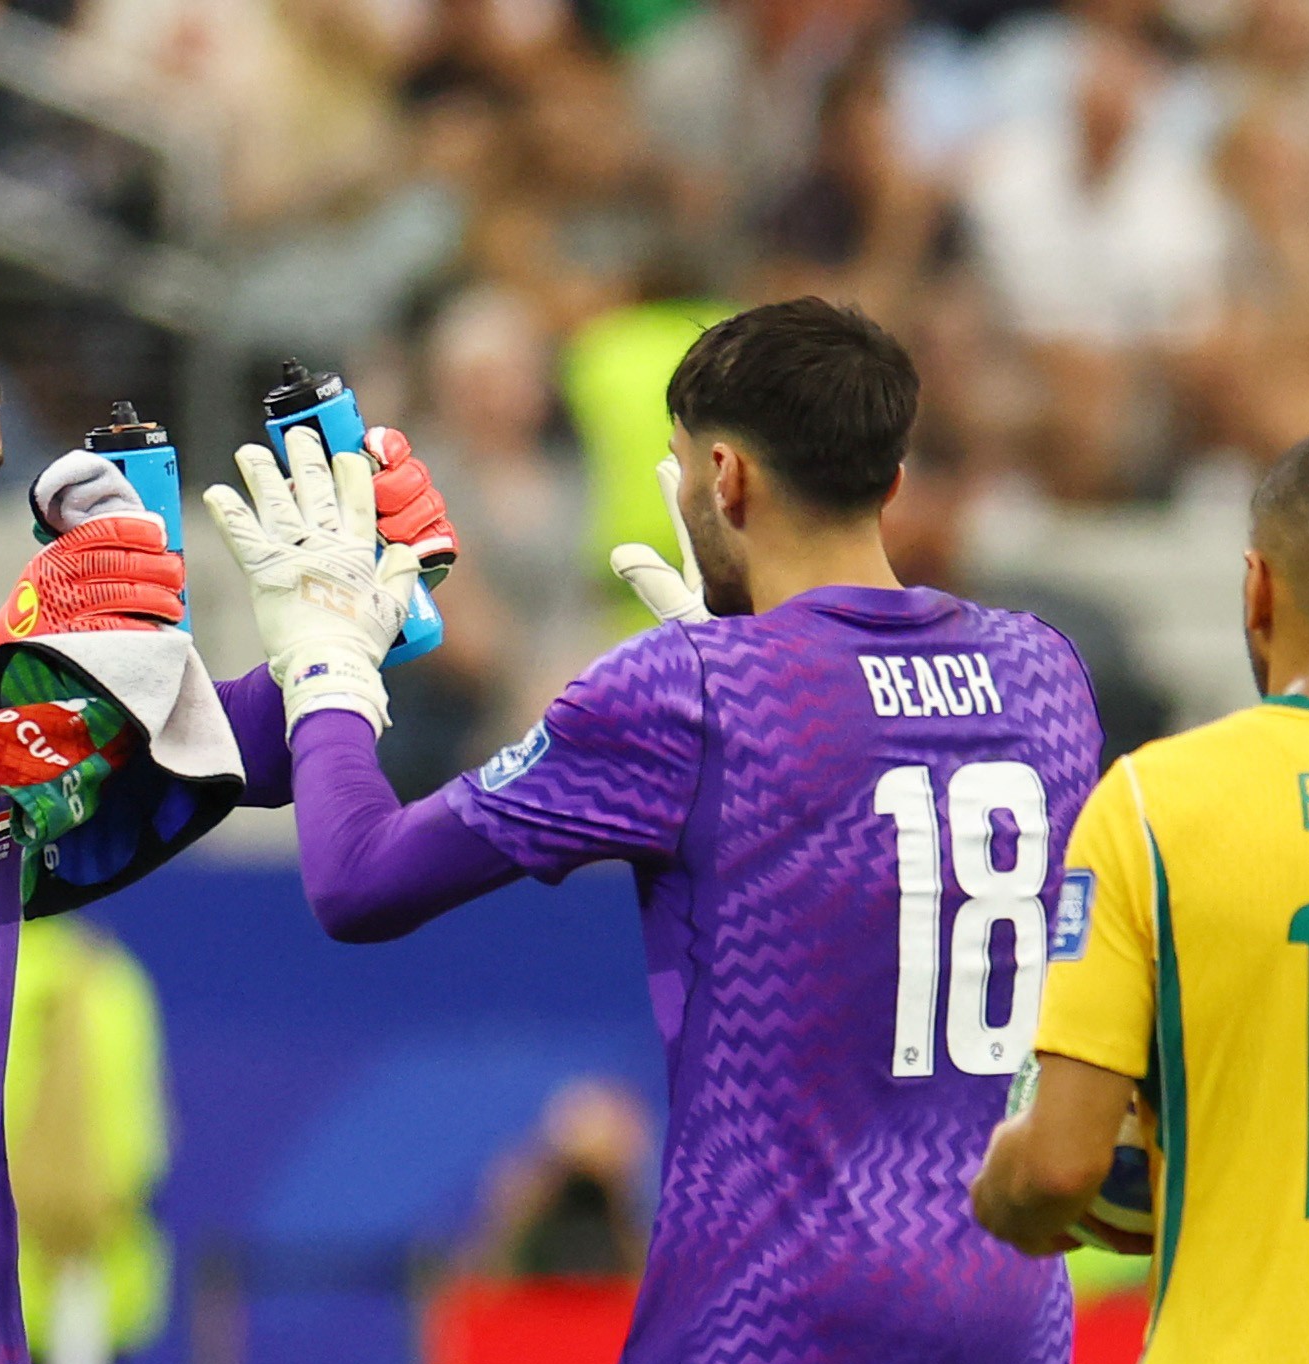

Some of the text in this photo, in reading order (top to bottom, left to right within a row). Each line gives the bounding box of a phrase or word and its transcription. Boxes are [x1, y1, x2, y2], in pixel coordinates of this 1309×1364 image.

[859, 654, 1002, 718] BEACH
[16, 720, 70, 766] CUP
[874, 762, 1048, 1077] 18
